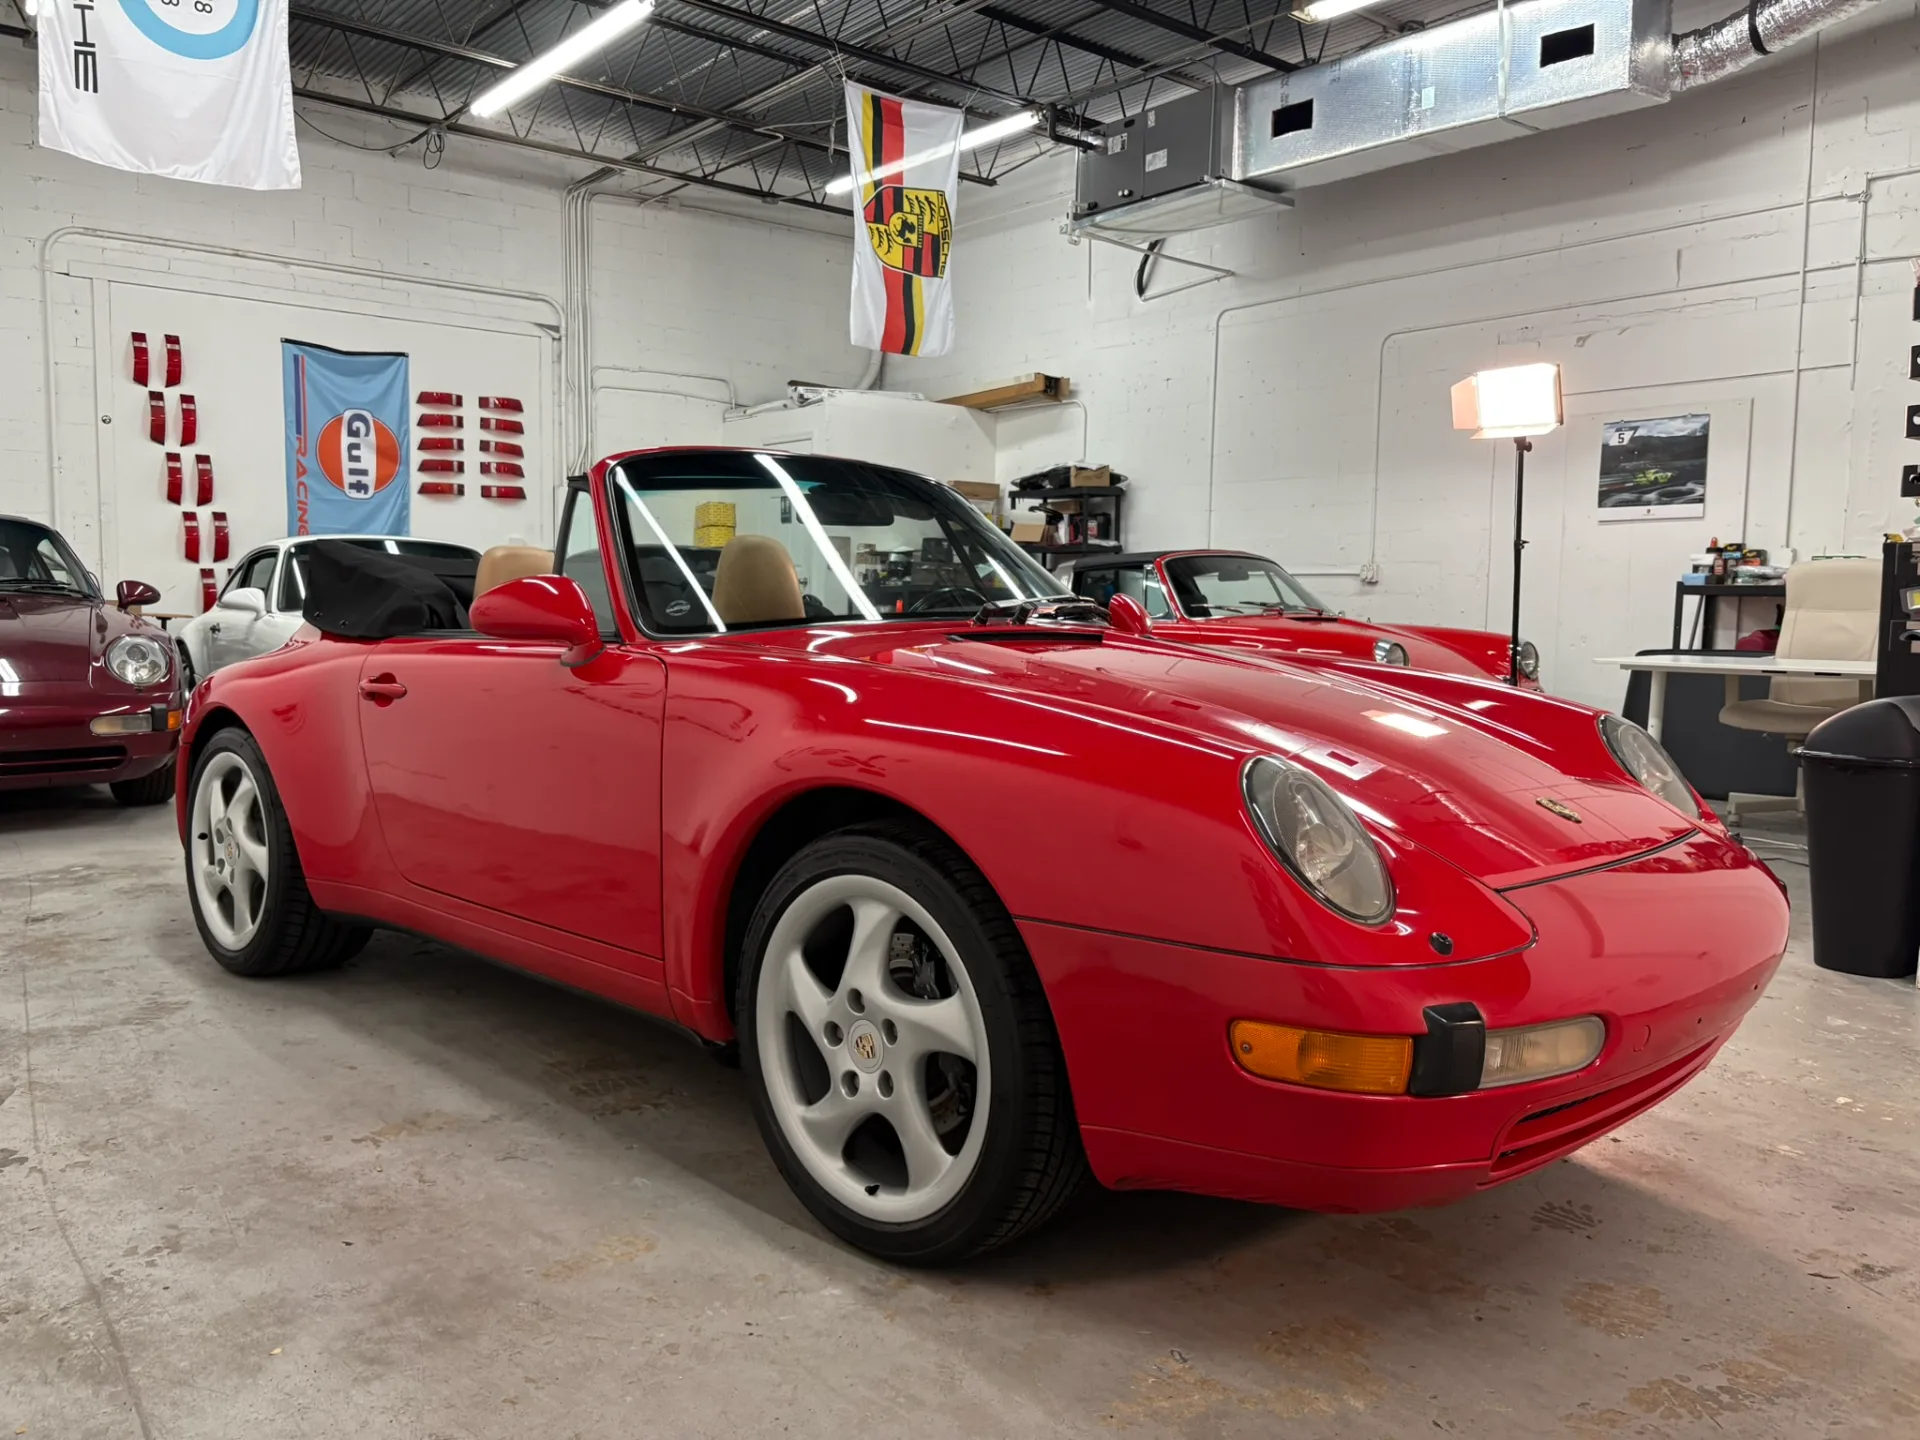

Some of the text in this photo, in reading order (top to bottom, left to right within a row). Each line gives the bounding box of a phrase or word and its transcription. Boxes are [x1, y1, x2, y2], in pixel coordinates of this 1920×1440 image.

[73, 0, 98, 94] HE
[939, 193, 950, 276] PORSCHE
[347, 412, 371, 495] Gulf
[1617, 432, 1625, 444] 5
